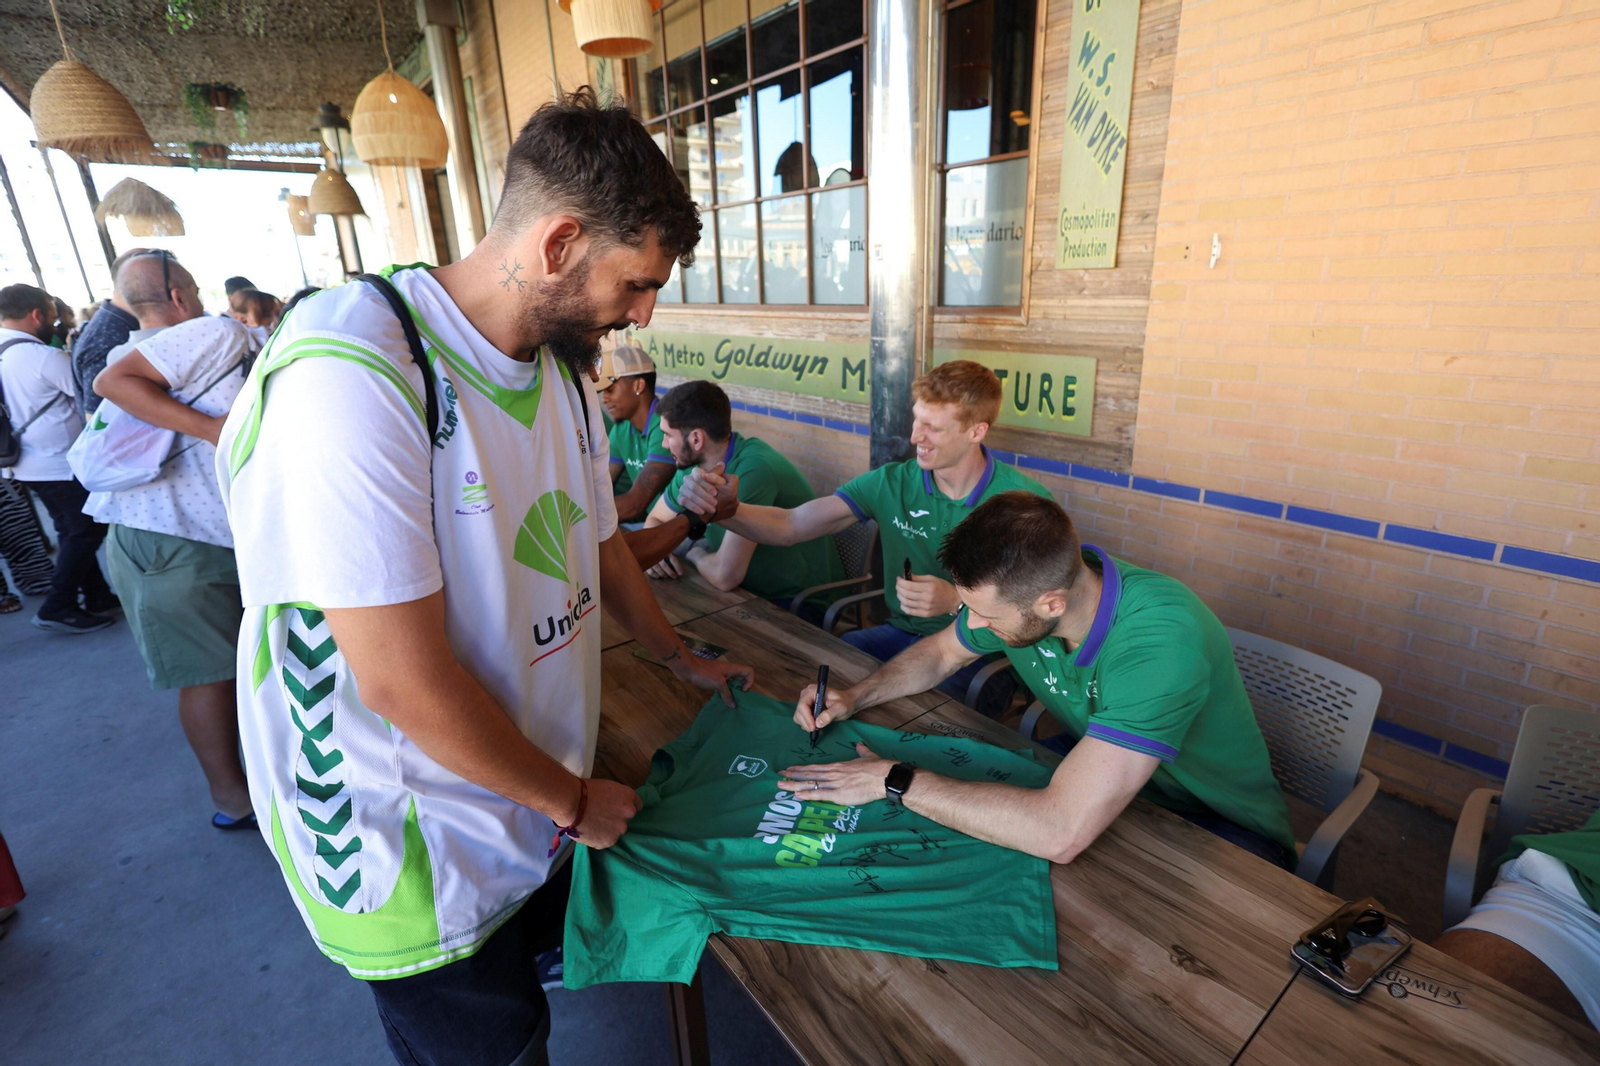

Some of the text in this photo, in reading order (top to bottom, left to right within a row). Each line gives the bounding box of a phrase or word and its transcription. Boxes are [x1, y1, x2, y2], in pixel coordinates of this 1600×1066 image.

[1066, 81, 1126, 176] VAN DYKE
[1061, 206, 1116, 237] Cosmopolitan
[1062, 236, 1108, 263] Production
[649, 335, 658, 355] A
[663, 342, 705, 369] Metro
[711, 338, 829, 382] Goldwyn
